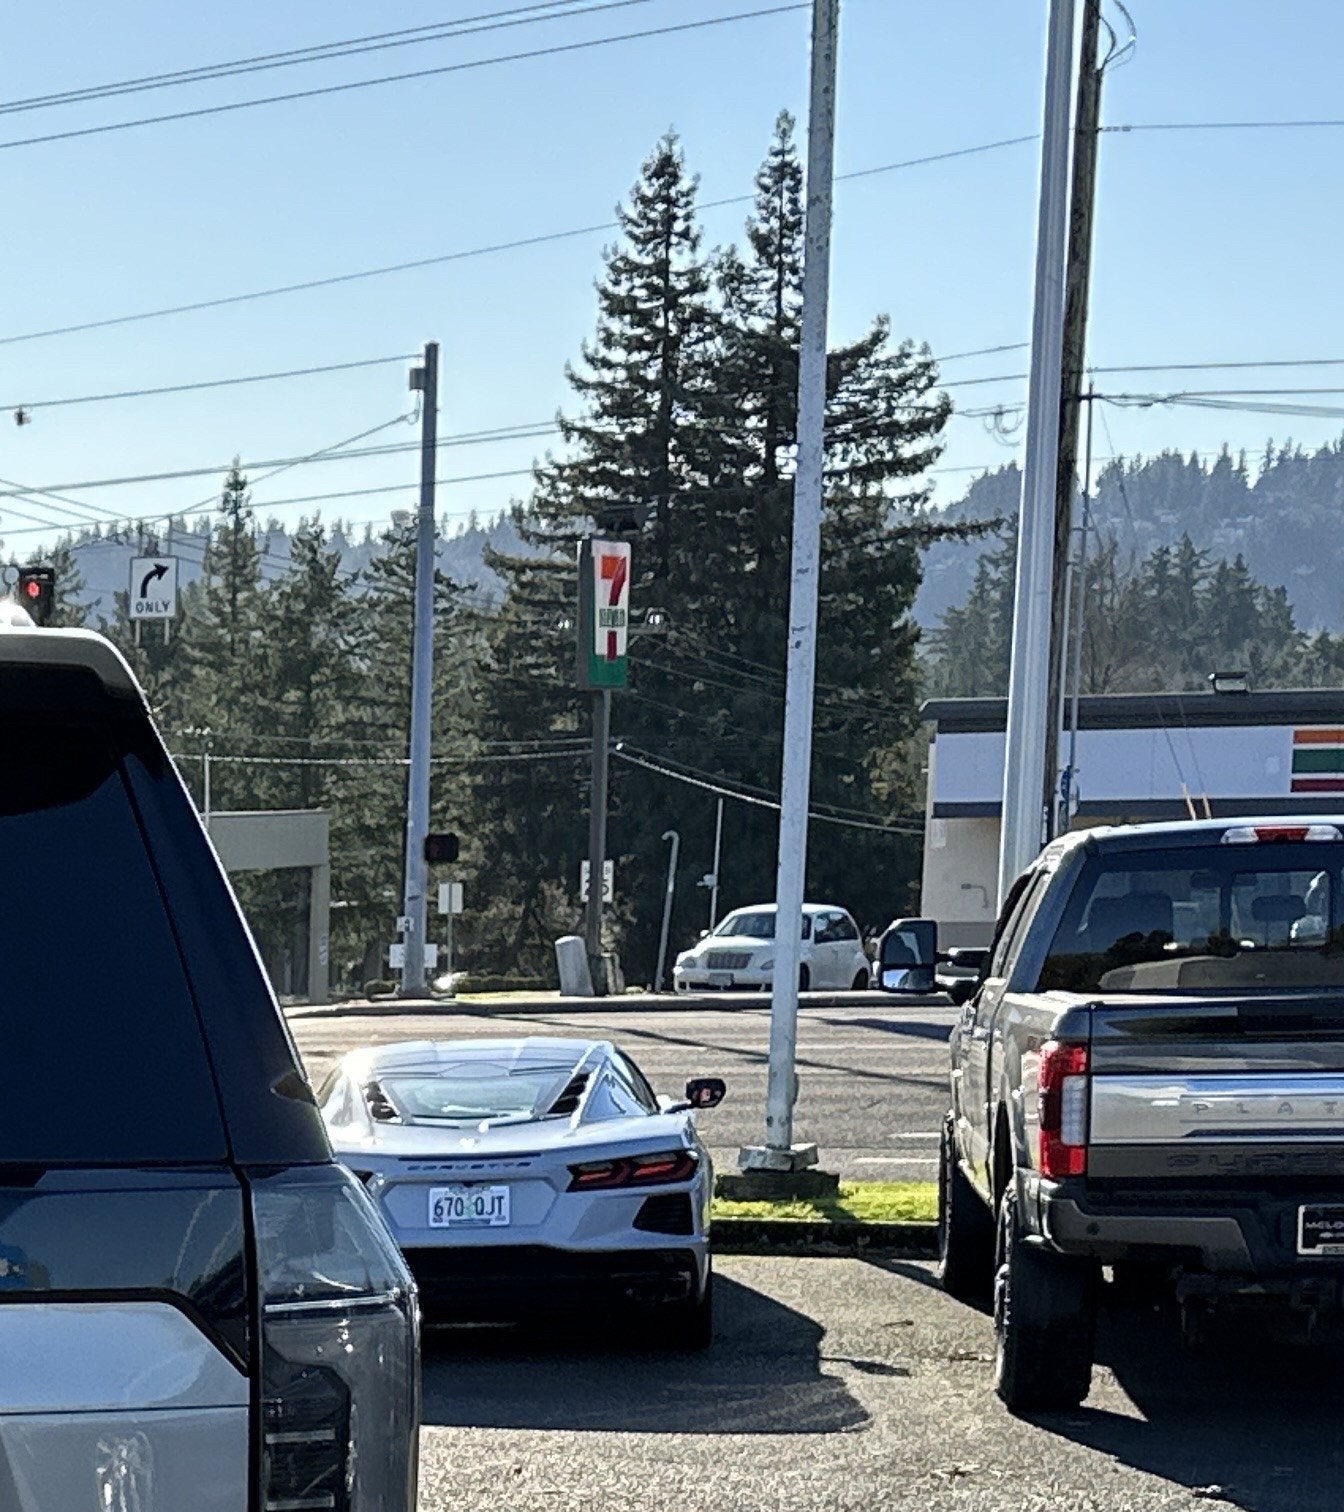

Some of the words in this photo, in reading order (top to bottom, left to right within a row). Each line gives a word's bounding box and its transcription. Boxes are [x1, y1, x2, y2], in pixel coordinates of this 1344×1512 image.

[135, 601, 171, 614] ONLY
[434, 1197, 465, 1217] 670
[473, 1195, 504, 1216] QJT
